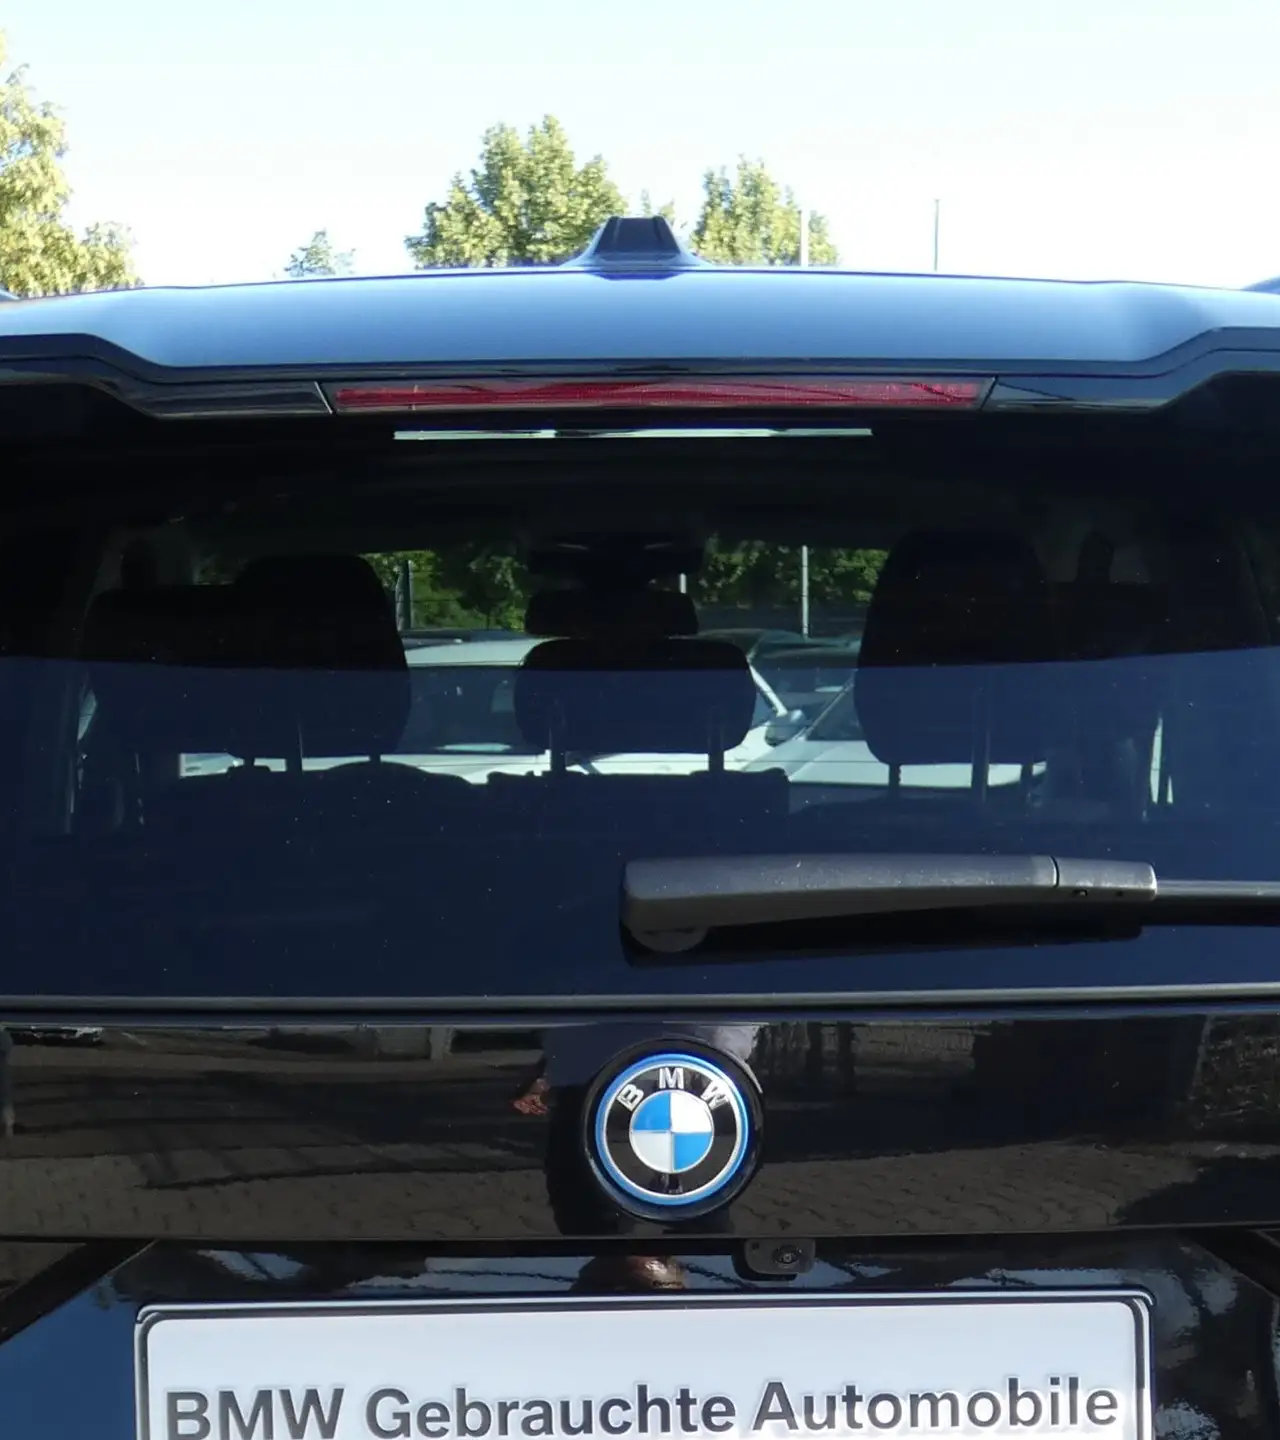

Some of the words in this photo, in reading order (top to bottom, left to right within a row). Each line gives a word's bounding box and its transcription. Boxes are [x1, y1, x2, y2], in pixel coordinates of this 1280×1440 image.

[617, 1067, 729, 1111] BMW
[366, 1384, 736, 1439] Gebrauchte
[752, 1376, 1119, 1431] Automobile
